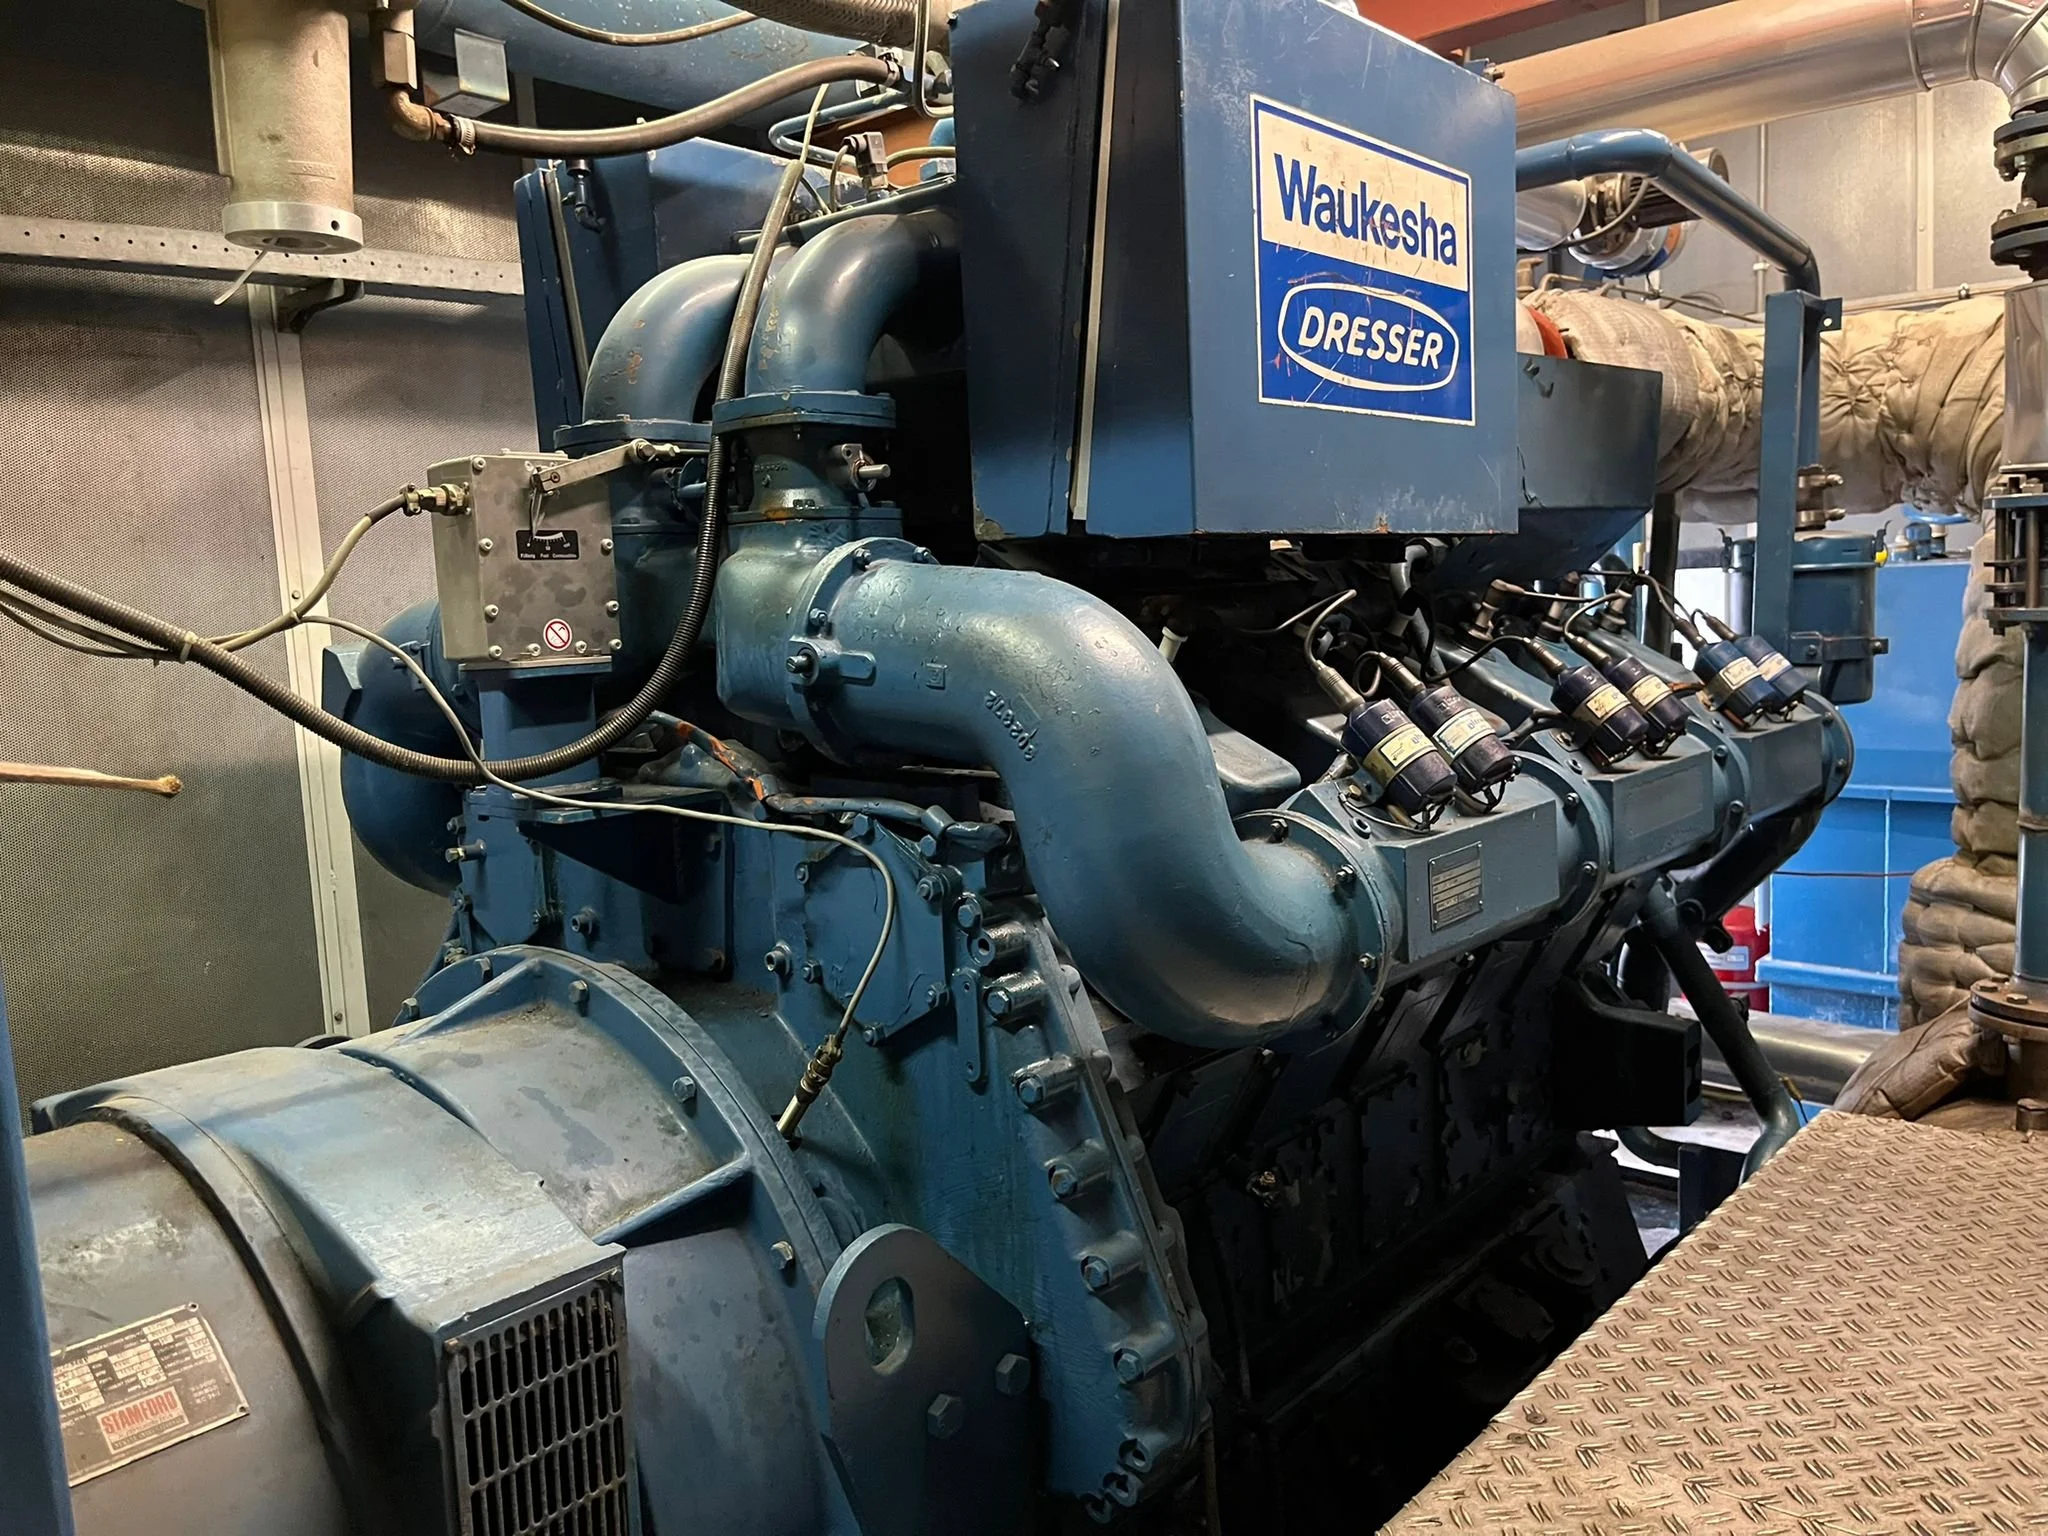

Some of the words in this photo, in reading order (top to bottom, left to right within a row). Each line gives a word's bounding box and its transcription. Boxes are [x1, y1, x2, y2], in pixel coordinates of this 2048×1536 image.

[1273, 152, 1457, 267] Waukesha
[1298, 306, 1443, 370] DRESSER
[101, 1391, 178, 1435] STAMFORD
